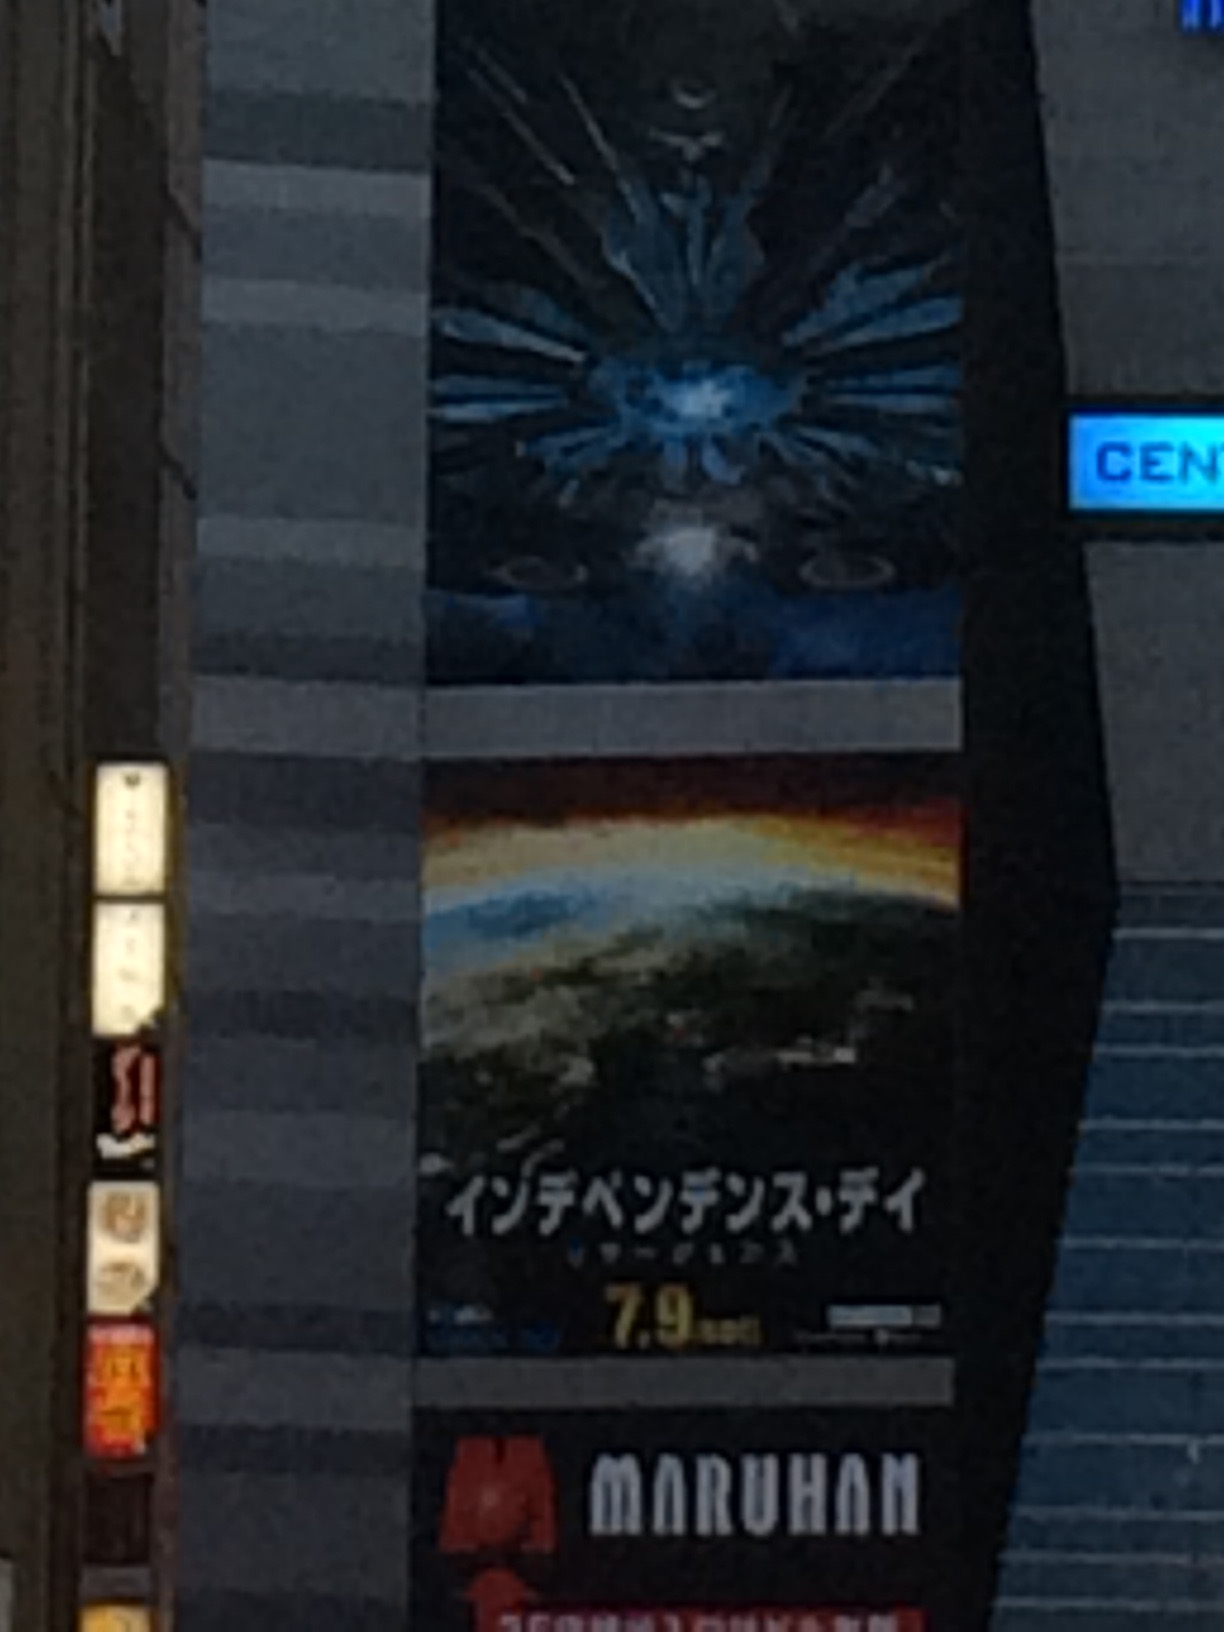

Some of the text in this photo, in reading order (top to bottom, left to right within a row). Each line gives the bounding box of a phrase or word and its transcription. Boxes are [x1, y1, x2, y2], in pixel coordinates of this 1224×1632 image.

[1096, 440, 1224, 485] CEN
[447, 1167, 926, 1236] インデペンデンス・デイ
[588, 1451, 921, 1537] MARUHAN
